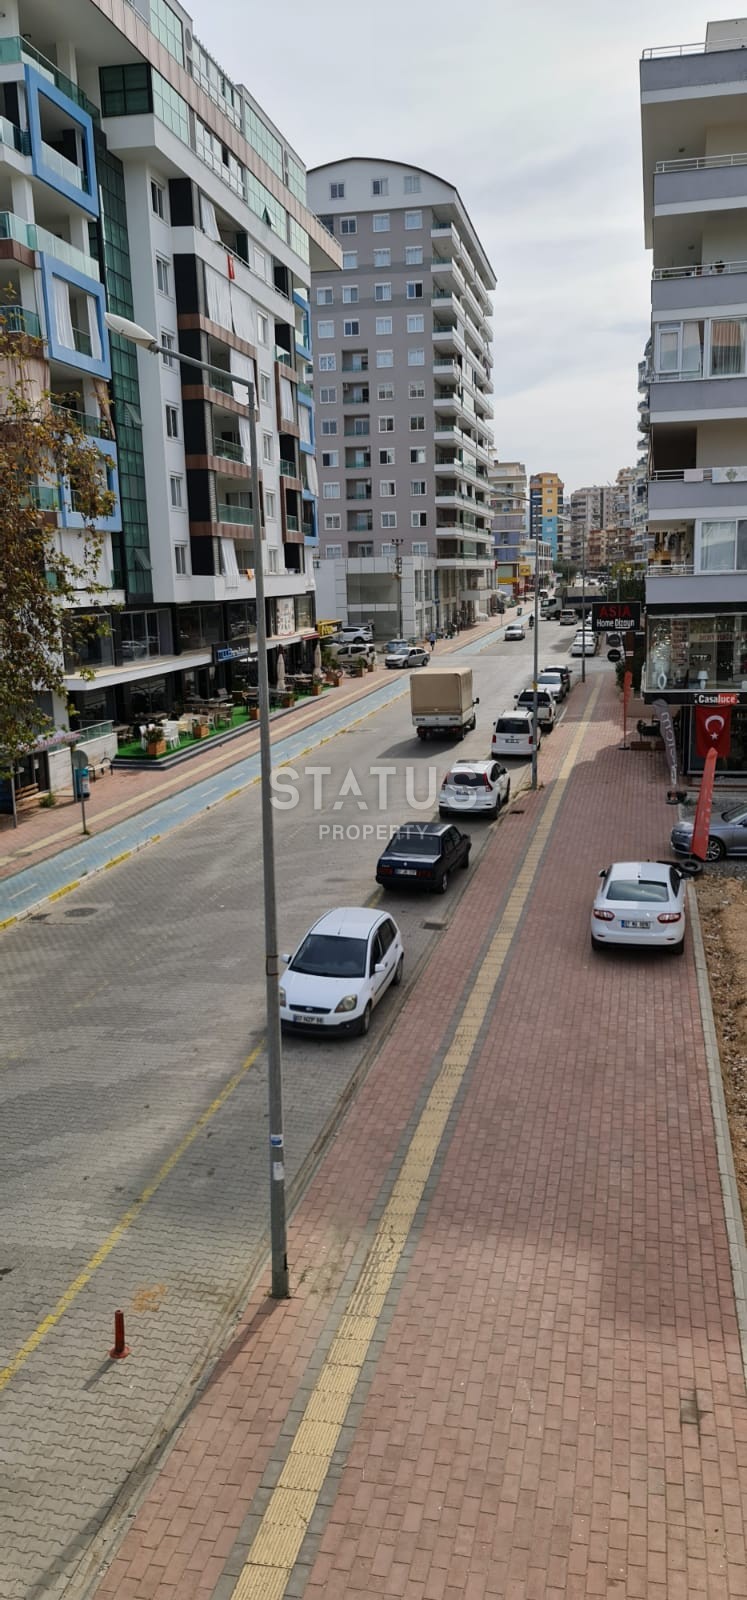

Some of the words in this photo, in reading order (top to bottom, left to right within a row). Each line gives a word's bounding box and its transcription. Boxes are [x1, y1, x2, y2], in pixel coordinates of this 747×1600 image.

[599, 606, 632, 618] ASIA
[597, 618, 614, 627] Home
[698, 693, 737, 704] Casaluce
